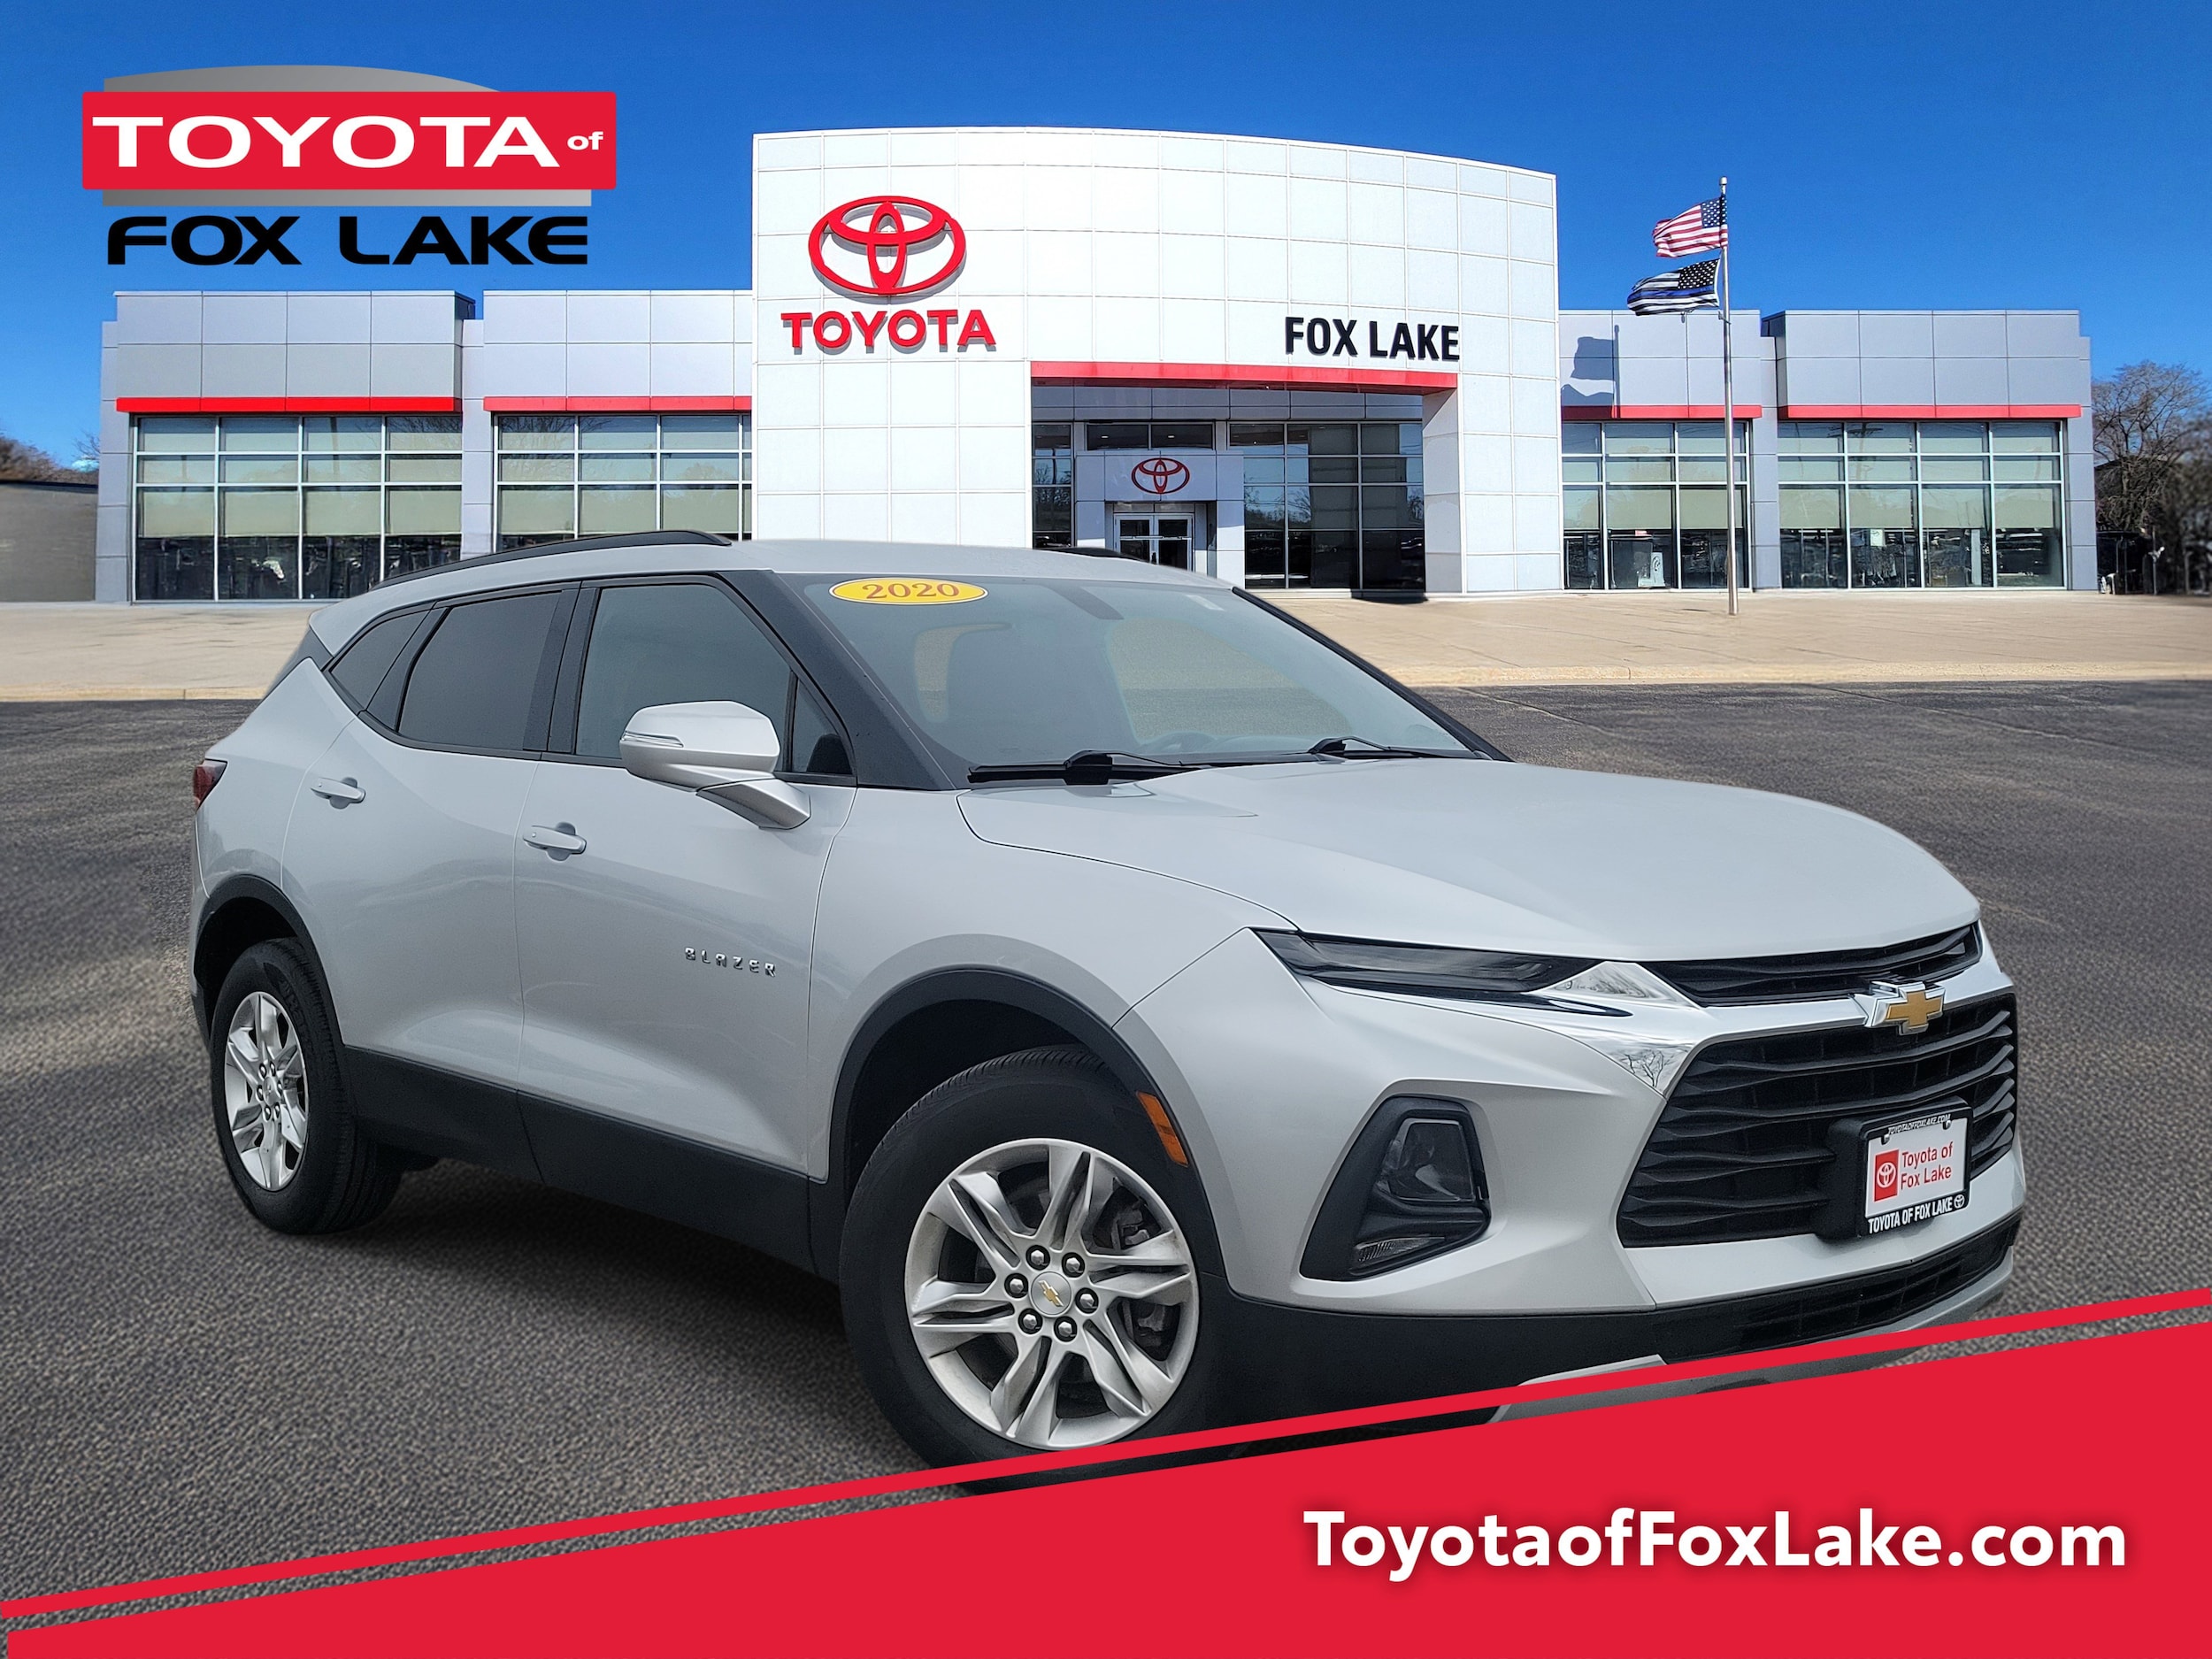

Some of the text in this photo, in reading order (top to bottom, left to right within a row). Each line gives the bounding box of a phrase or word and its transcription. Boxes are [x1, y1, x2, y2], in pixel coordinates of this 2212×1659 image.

[780, 309, 997, 350] TOYOTA
[1286, 317, 1460, 361] FOX LAKE
[862, 582, 960, 599] 2020
[685, 947, 776, 978] BLAZER
[1901, 1141, 1954, 1170] Toyota of
[1901, 1164, 1952, 1190] Fox Lake
[1868, 1196, 1953, 1233] TOYOTA OF FOX LAKE
